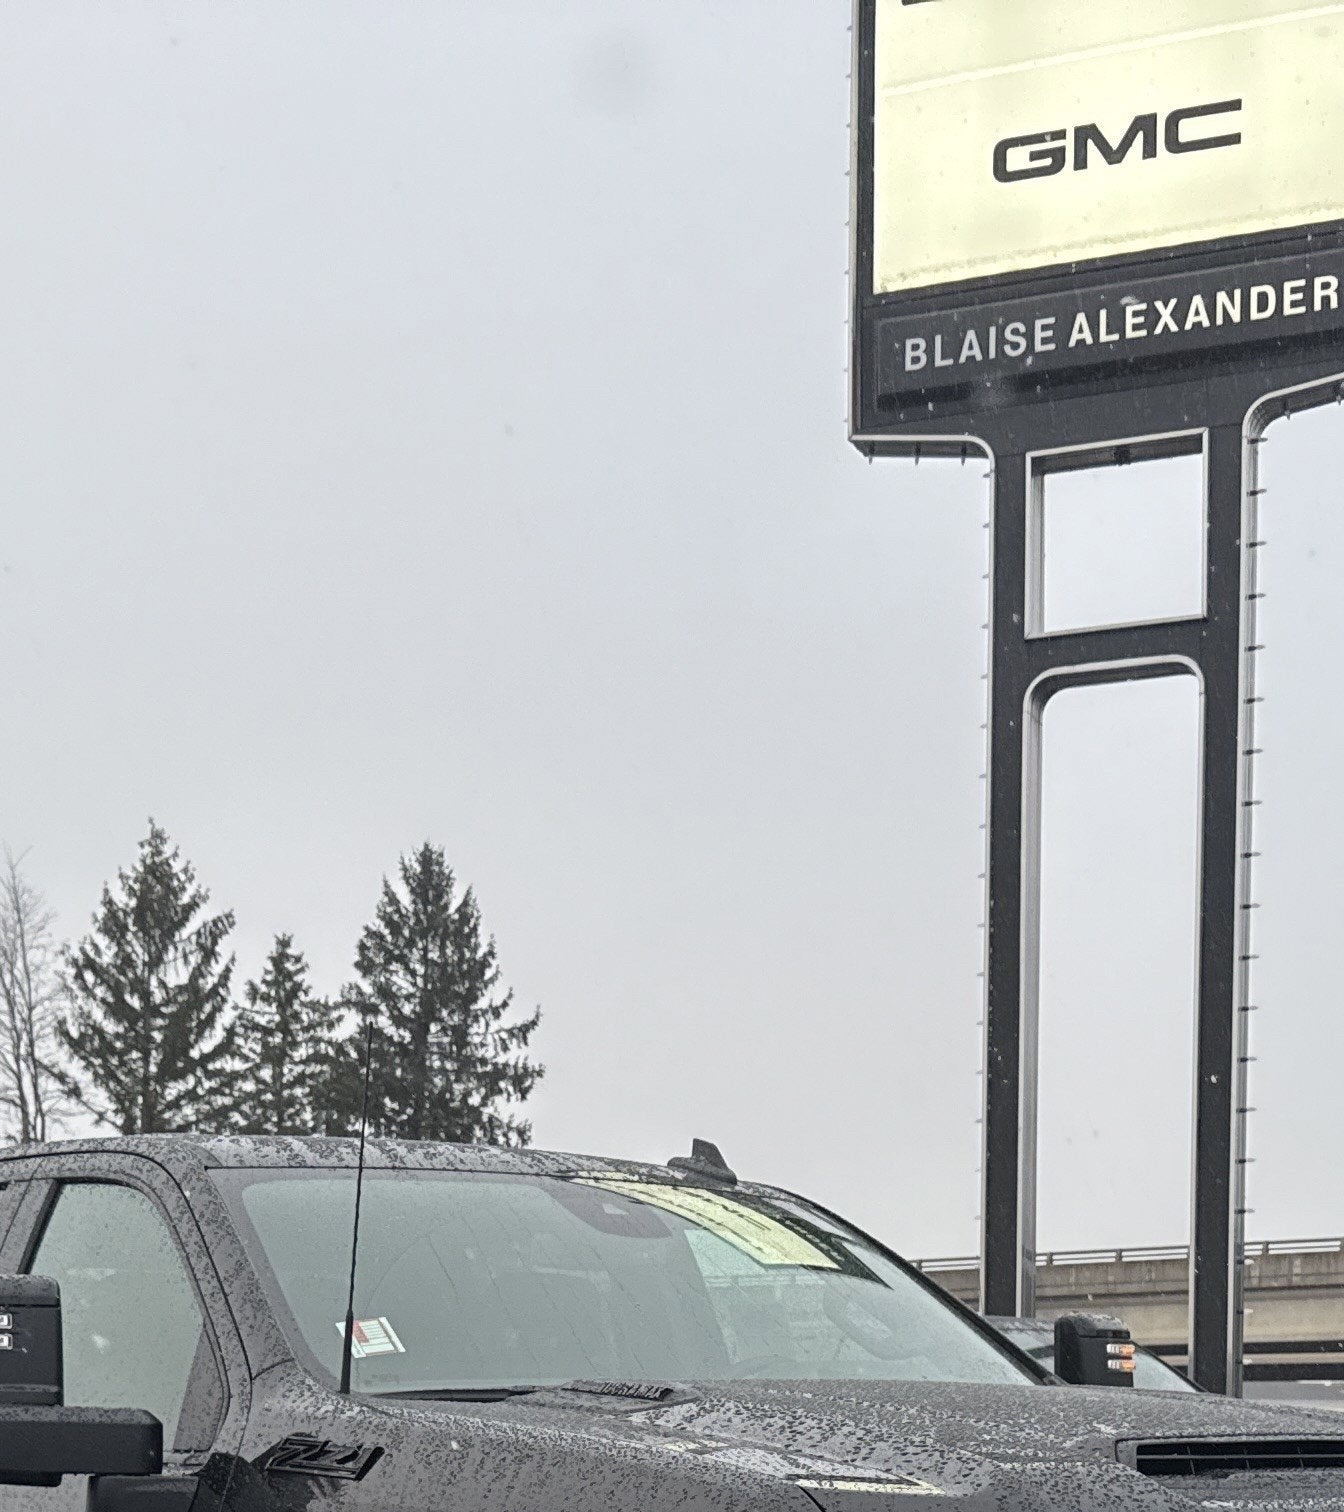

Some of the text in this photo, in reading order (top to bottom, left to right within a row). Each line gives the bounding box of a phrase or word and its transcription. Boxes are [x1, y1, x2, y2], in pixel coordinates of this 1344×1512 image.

[992, 98, 1243, 183] GMC
[903, 275, 1340, 373] BLAISE ALEXANDER
